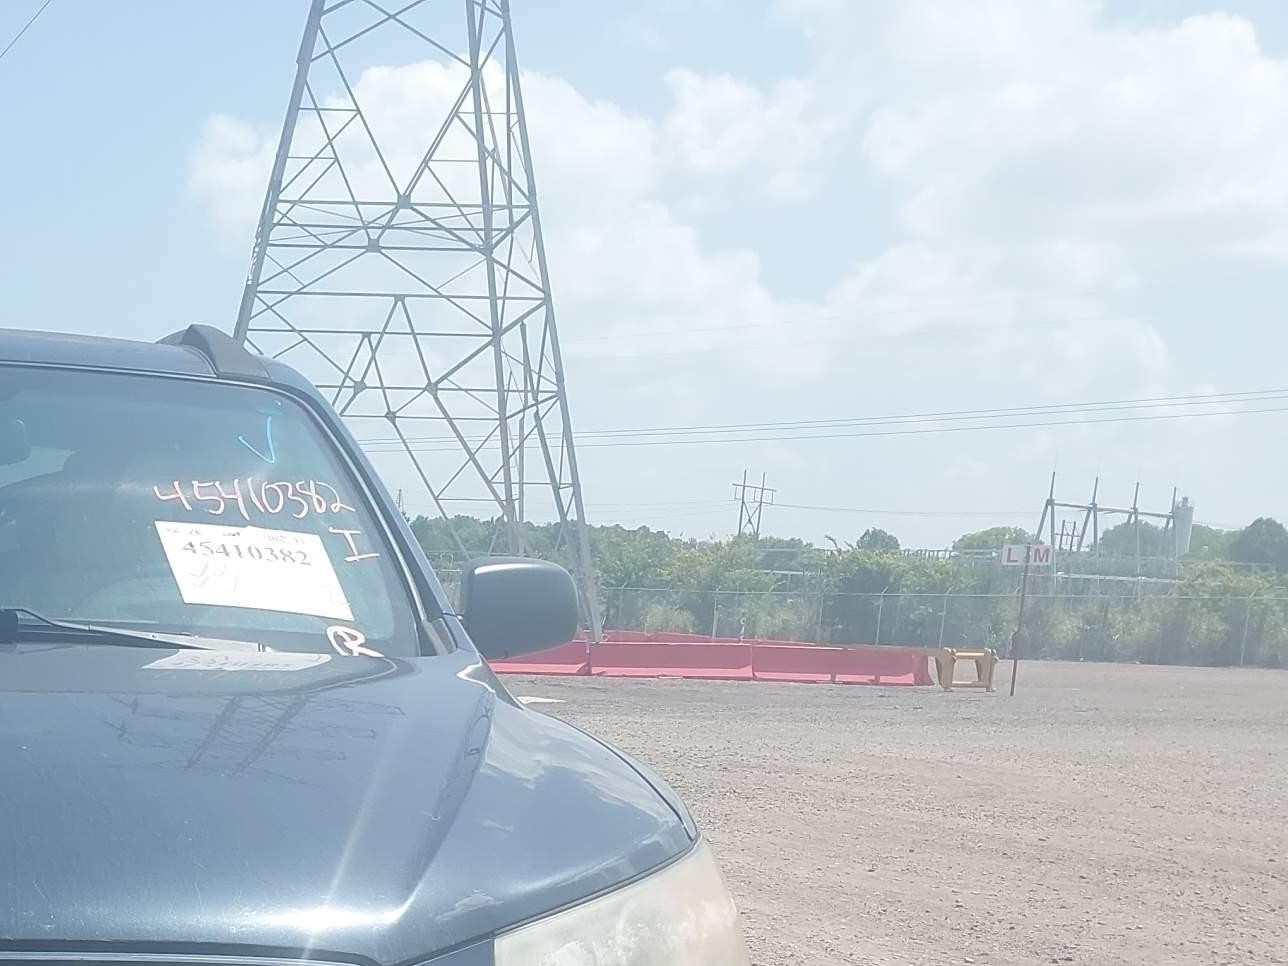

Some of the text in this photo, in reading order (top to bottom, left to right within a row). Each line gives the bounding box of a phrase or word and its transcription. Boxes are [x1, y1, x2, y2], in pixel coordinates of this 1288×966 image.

[153, 478, 356, 520] 45410382
[182, 541, 312, 566] 45410382
[1006, 547, 1050, 563] L M
